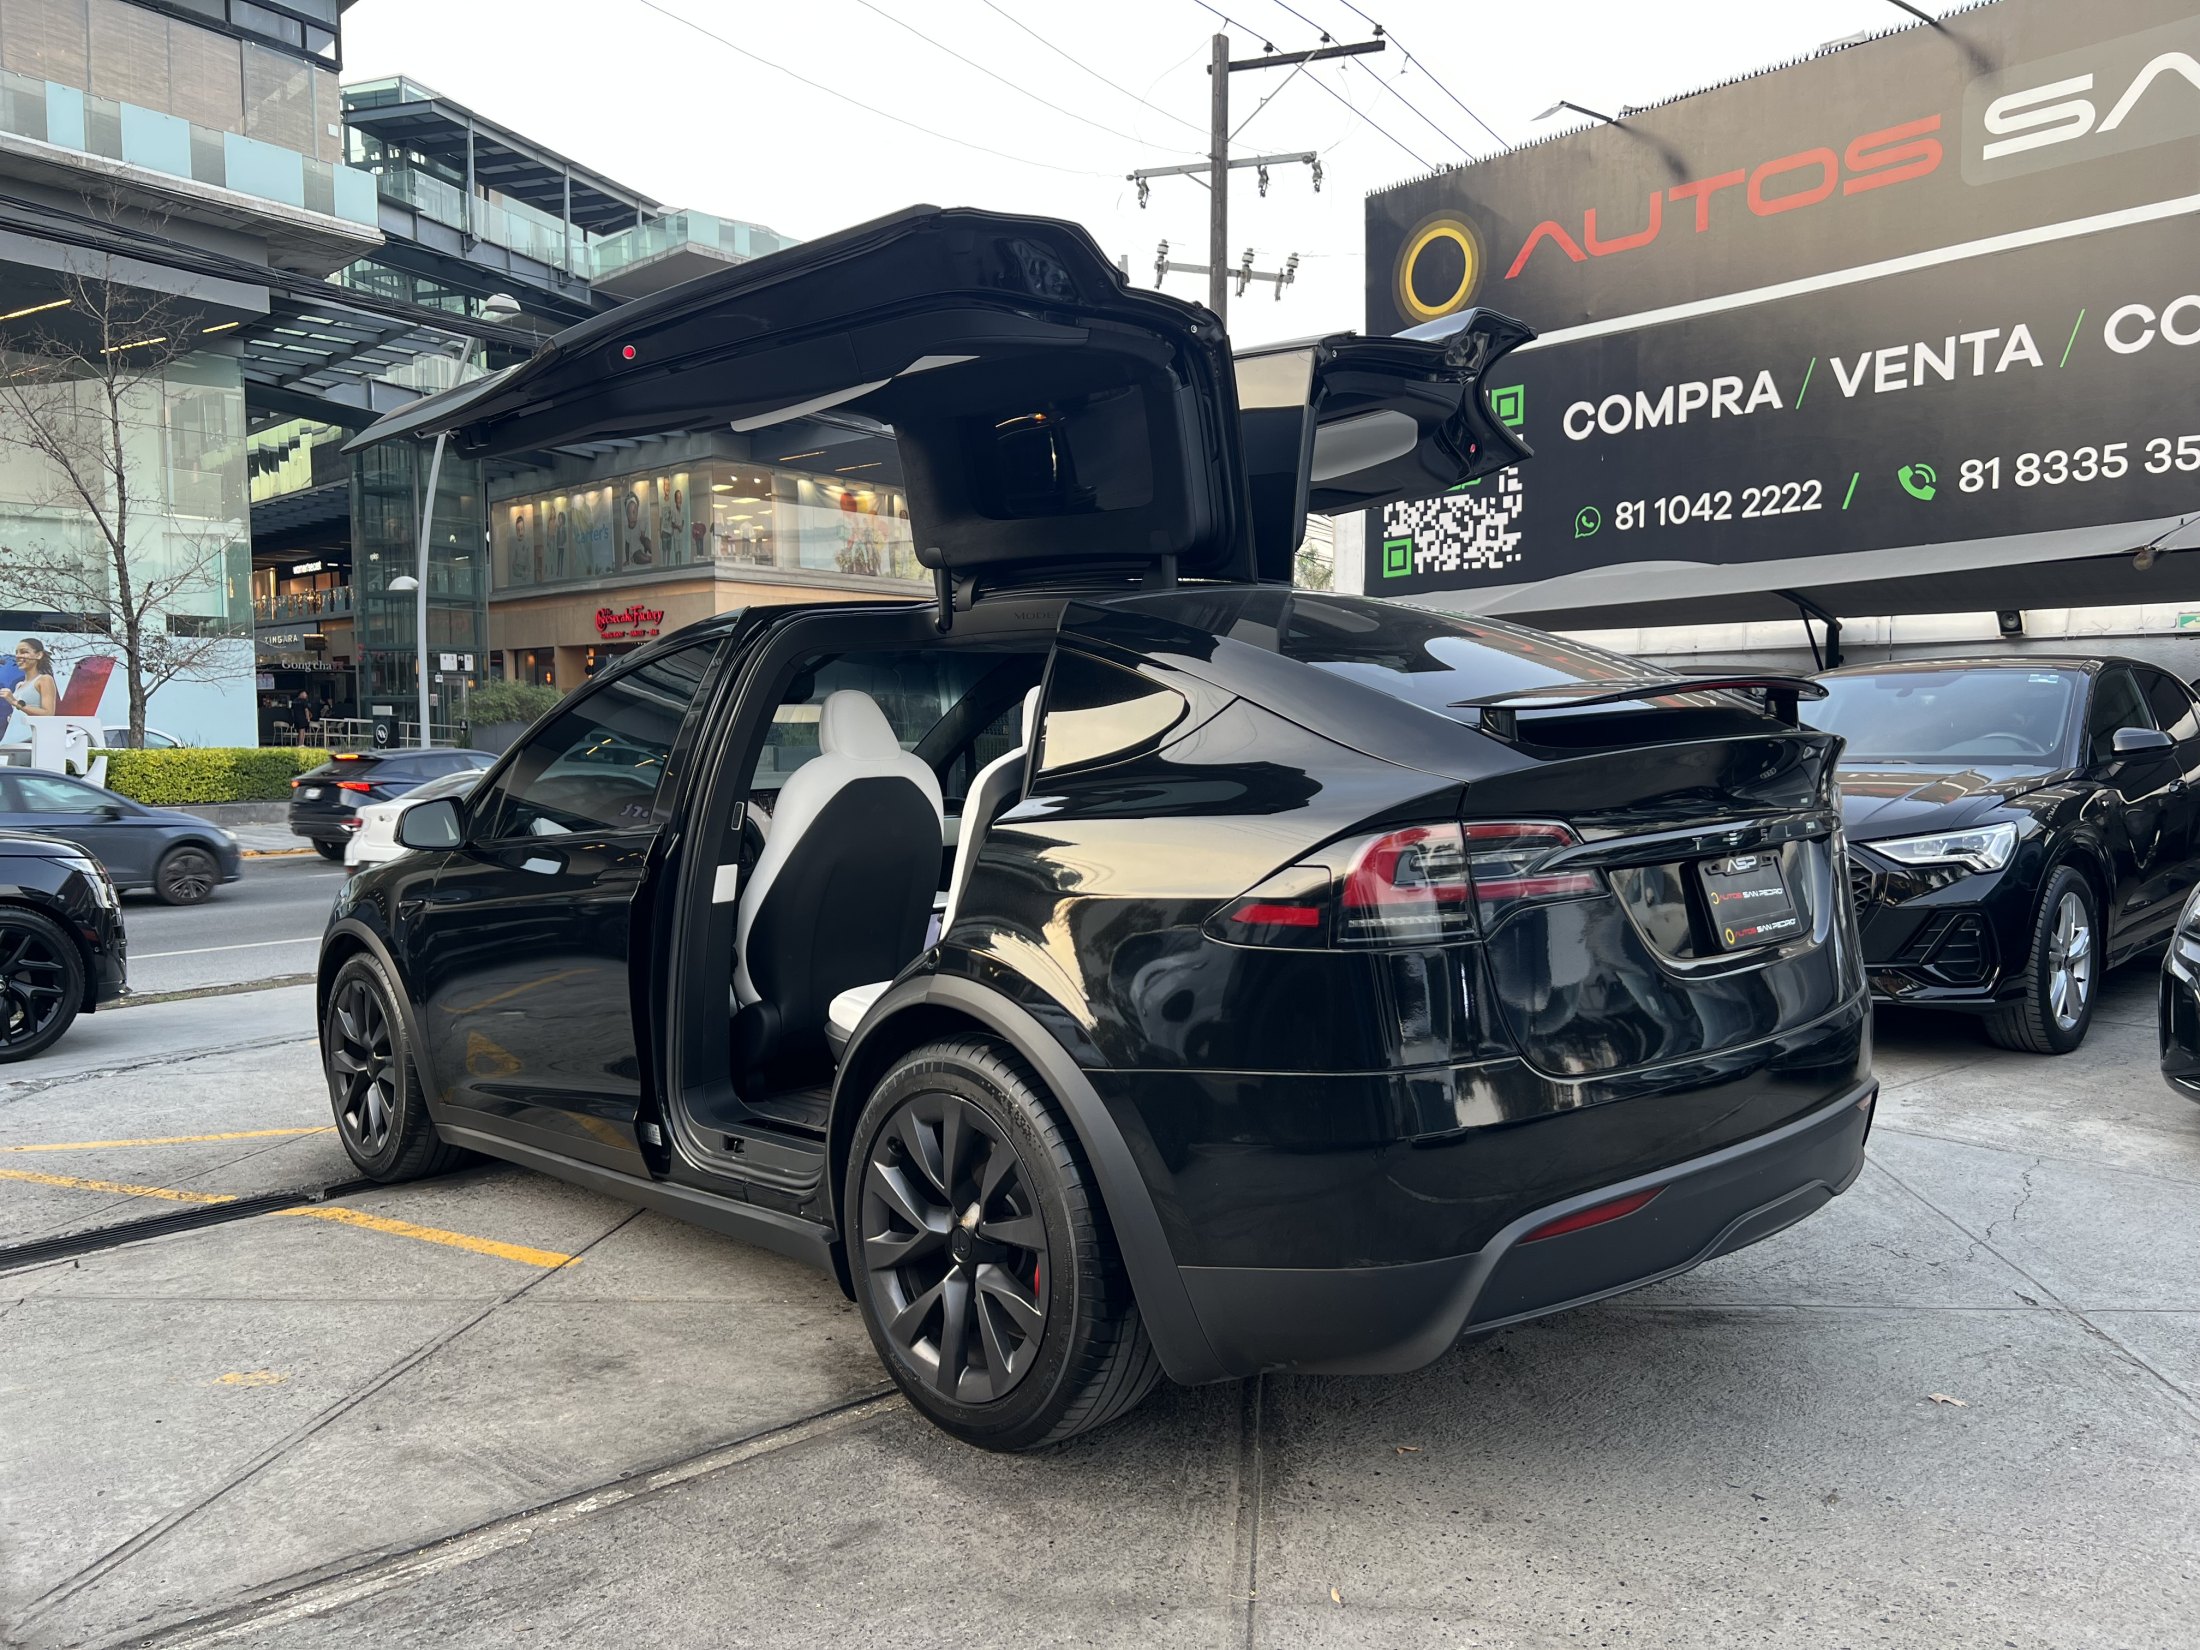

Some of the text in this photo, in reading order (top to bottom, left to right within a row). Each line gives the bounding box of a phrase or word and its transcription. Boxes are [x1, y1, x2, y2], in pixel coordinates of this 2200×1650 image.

[1505, 116, 1942, 279] AUTOS
[1563, 369, 1784, 442] COMPRA
[1829, 323, 2044, 398] VENTA
[1615, 500, 1645, 531] 81
[1654, 490, 1732, 526] 1042
[1741, 479, 1822, 519] 2222
[1958, 456, 2000, 493] 81
[2014, 442, 2129, 487] 8335
[2144, 434, 2200, 474] 35
[281, 660, 311, 672] Gong
[313, 659, 332, 670] cha
[1727, 855, 1757, 872] ASP
